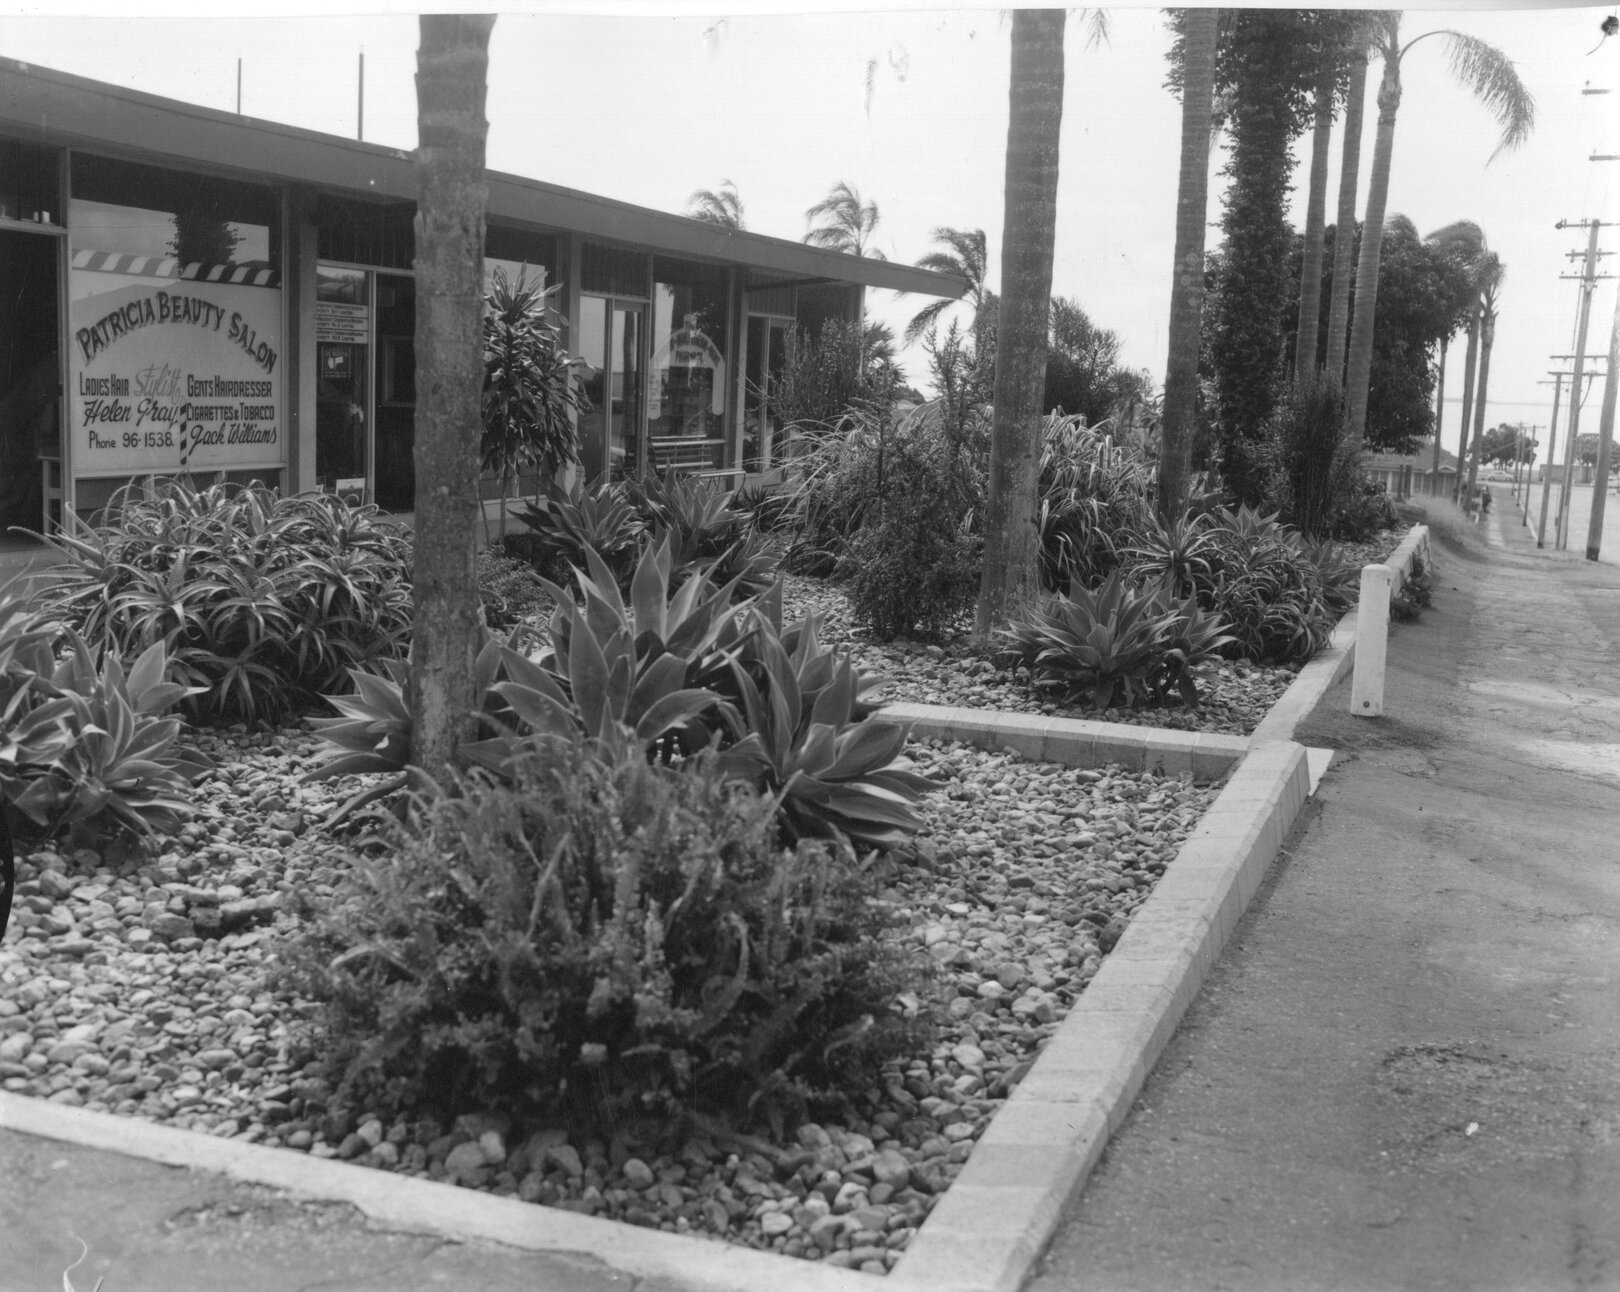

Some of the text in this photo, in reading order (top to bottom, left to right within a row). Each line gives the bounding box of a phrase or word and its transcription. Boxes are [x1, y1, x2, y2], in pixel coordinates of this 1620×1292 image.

[76, 291, 278, 374] PATRICIA BEAUTY SALON
[80, 371, 110, 396] LADIES
[110, 373, 130, 396] HAIR
[187, 374, 272, 397] GENTS HAIRDRESSER
[83, 398, 132, 427] Helen
[186, 402, 233, 421] CIGARETTES
[240, 402, 275, 420] TOBACCO
[89, 430, 117, 449] Phone
[188, 422, 277, 456] Jack Williams
